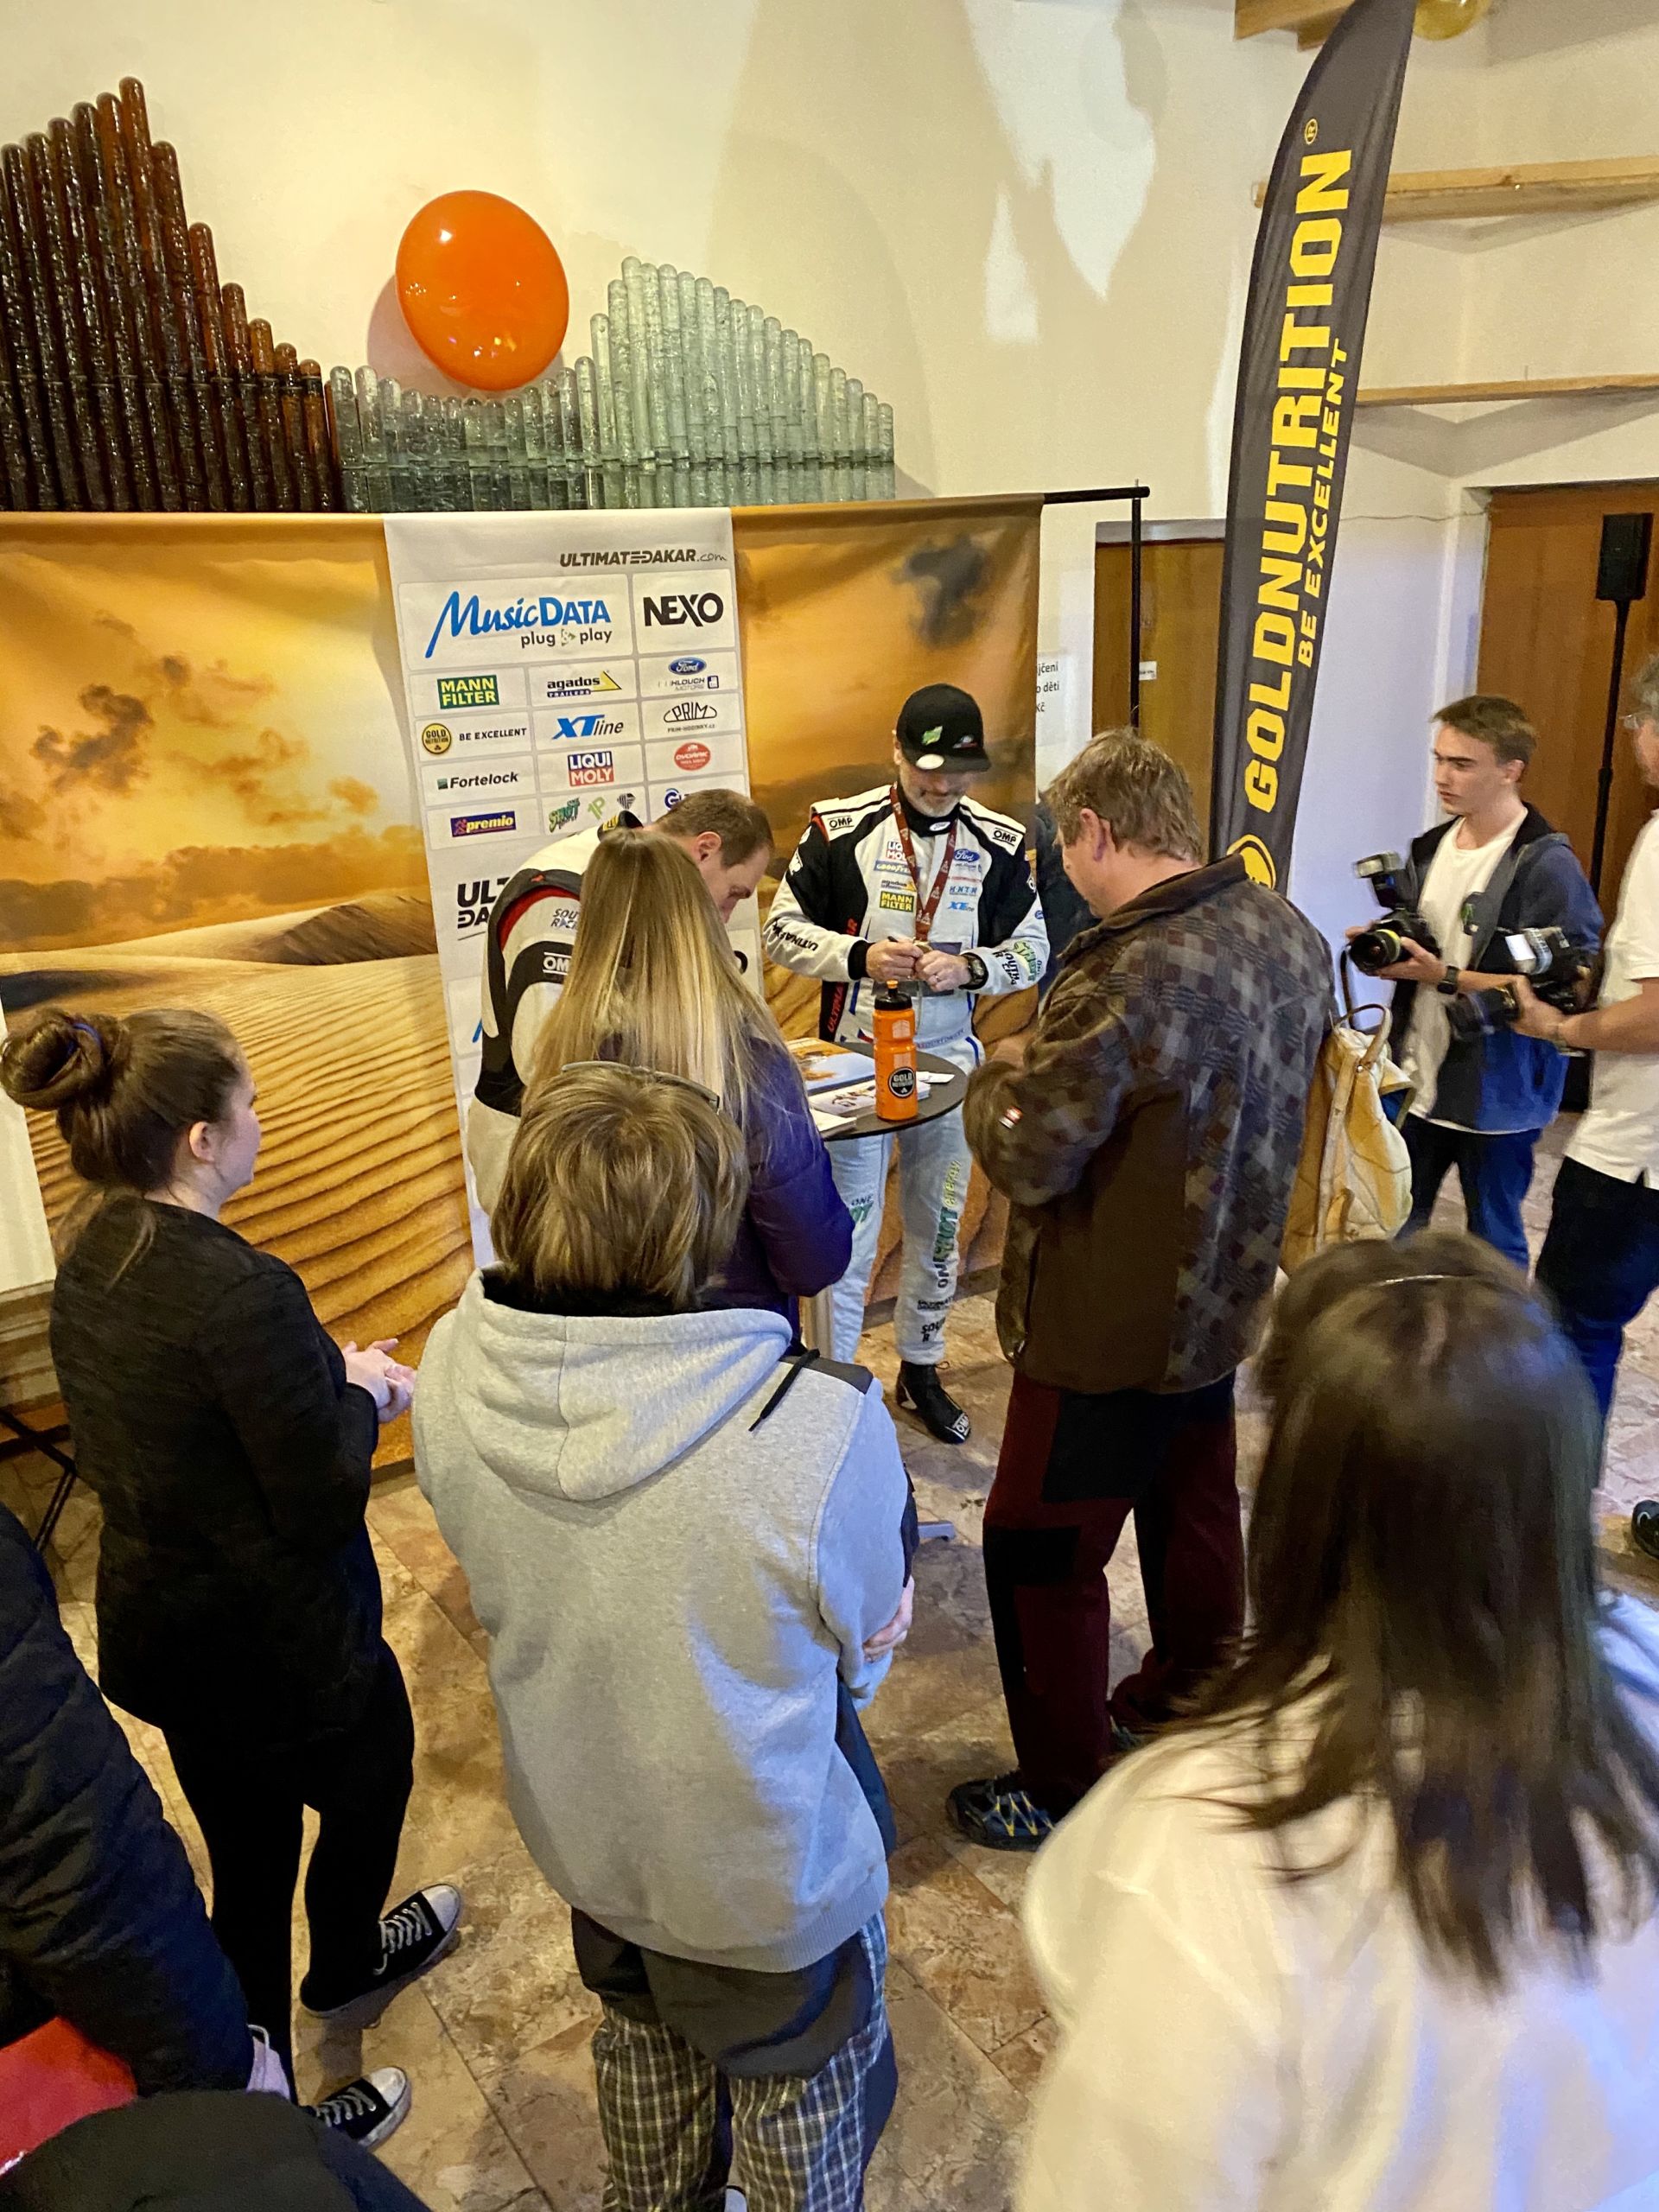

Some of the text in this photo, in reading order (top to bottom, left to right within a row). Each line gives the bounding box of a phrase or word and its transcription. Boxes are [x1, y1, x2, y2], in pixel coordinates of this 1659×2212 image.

[1244, 149, 1352, 813] GOLDNUTRITION
[1298, 338, 1349, 668] BE EXCELLENT
[643, 592, 724, 627] NEXO
[521, 632, 556, 649] plug
[580, 627, 613, 645] play
[441, 677, 494, 693] MANN
[547, 677, 601, 690] agados
[1043, 680, 1059, 692] děti
[442, 690, 496, 706] FILTER
[426, 729, 446, 739] GOLD
[459, 728, 527, 741] BE EXCELLENT
[569, 752, 612, 769] LIQUI
[449, 772, 518, 789] Fortelock
[570, 767, 614, 785] MOLY
[466, 816, 513, 833] premio
[830, 817, 853, 829] OMP
[994, 830, 1017, 843] OMP
[887, 849, 907, 861] MOL
[880, 899, 912, 912] FILTER
[882, 893, 912, 904] MANN
[543, 956, 569, 973] OM
